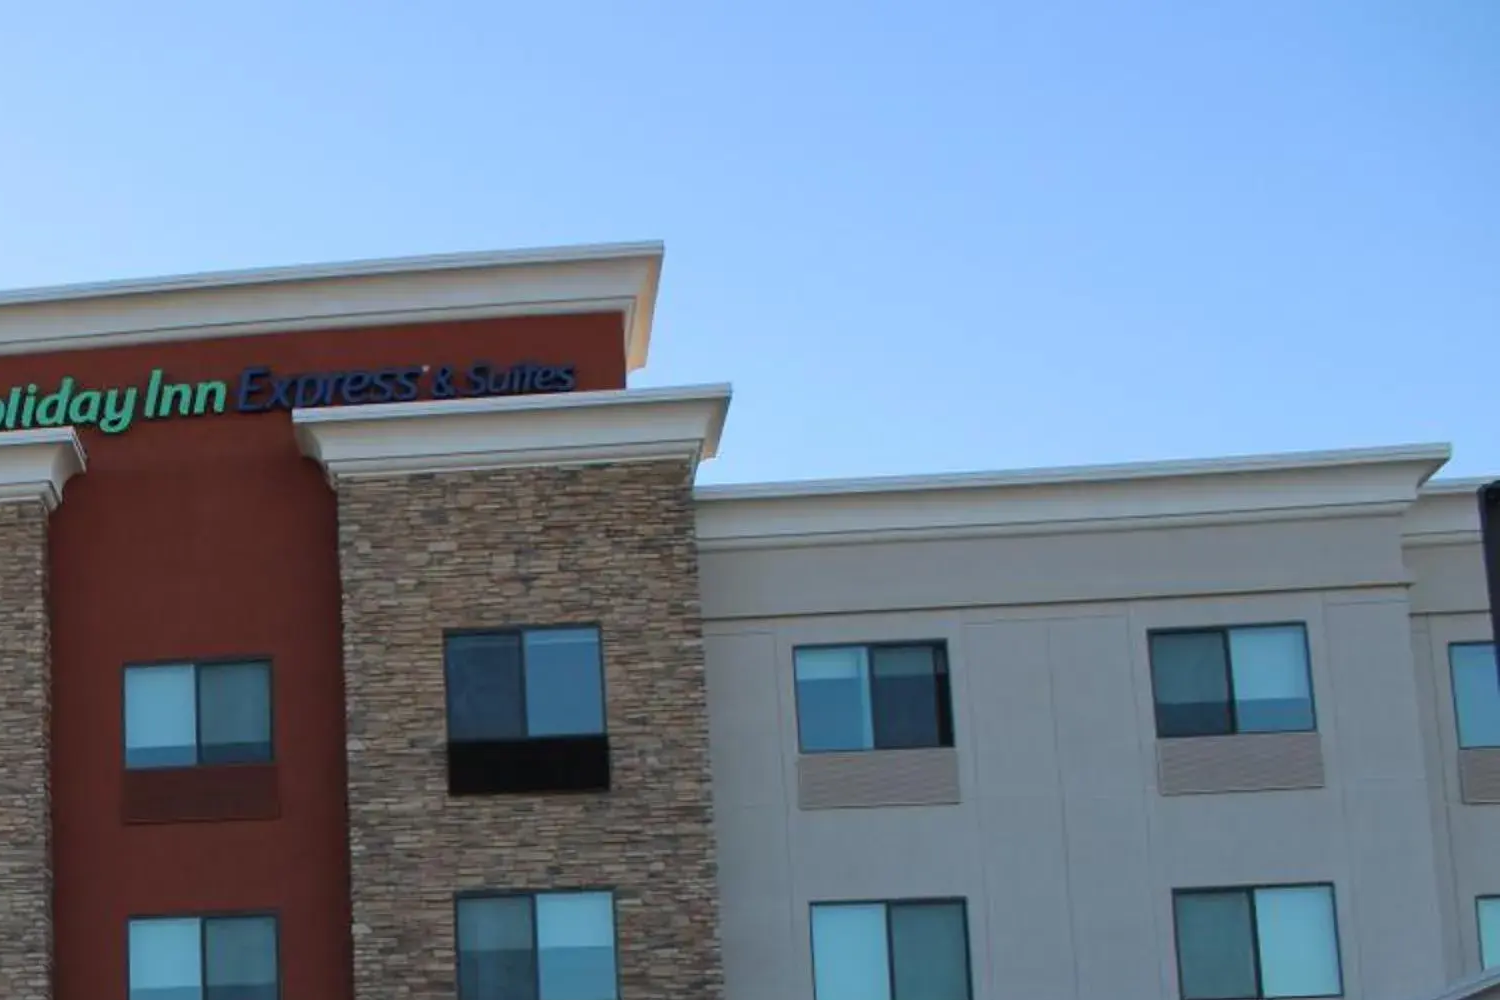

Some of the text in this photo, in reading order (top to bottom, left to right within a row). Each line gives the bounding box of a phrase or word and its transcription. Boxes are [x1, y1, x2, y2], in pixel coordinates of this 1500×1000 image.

[144, 368, 227, 419] Inn
[236, 364, 422, 411] Express
[431, 363, 455, 397] &
[466, 359, 576, 397] Suites
